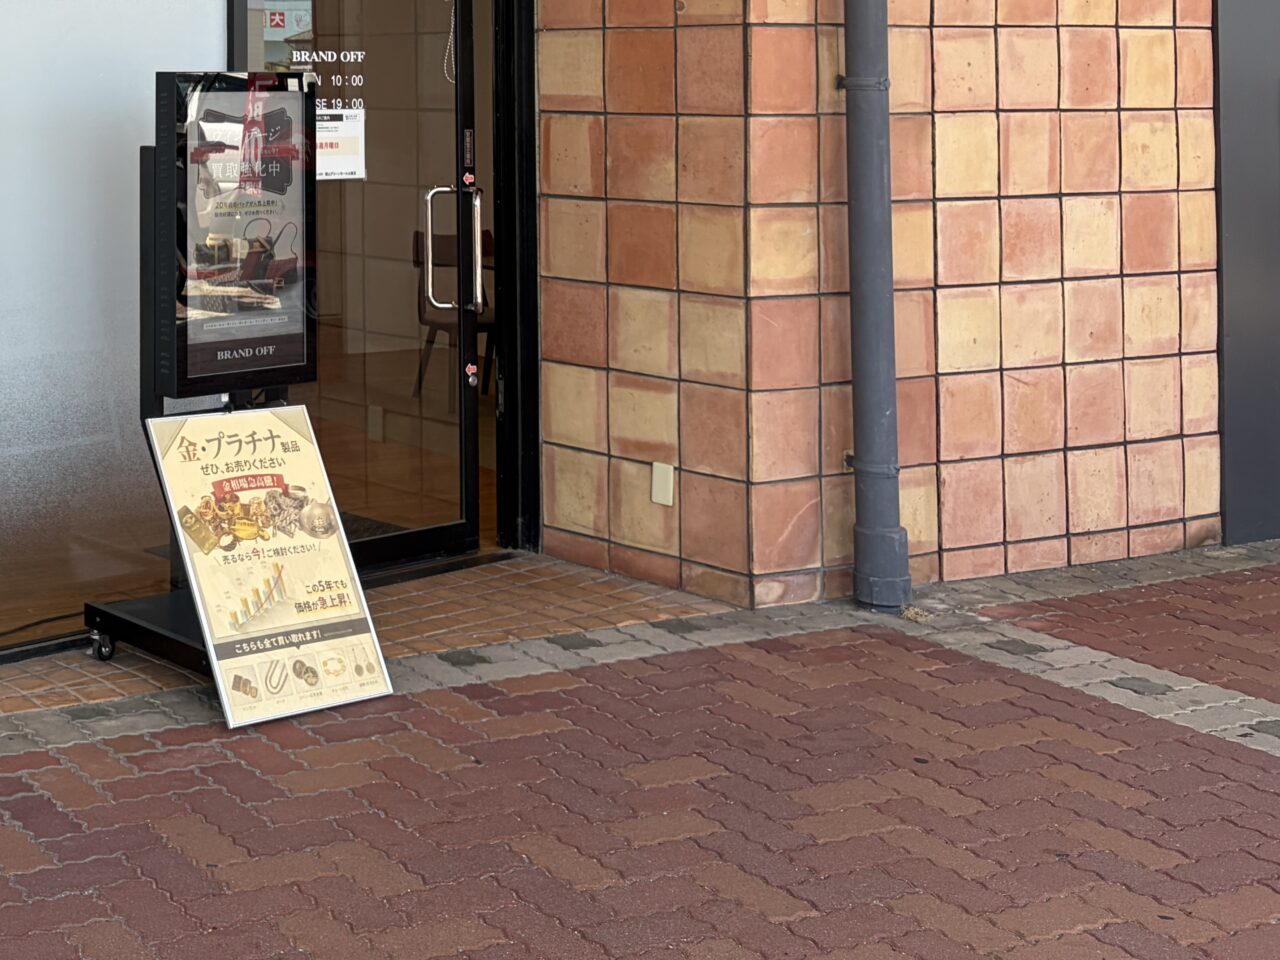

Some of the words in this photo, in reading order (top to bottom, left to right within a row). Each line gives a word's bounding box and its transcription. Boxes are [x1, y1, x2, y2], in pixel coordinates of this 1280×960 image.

[292, 50, 337, 62] BRAND
[340, 51, 366, 62] OFF
[217, 348, 253, 360] BRAND
[255, 345, 276, 357] OFF
